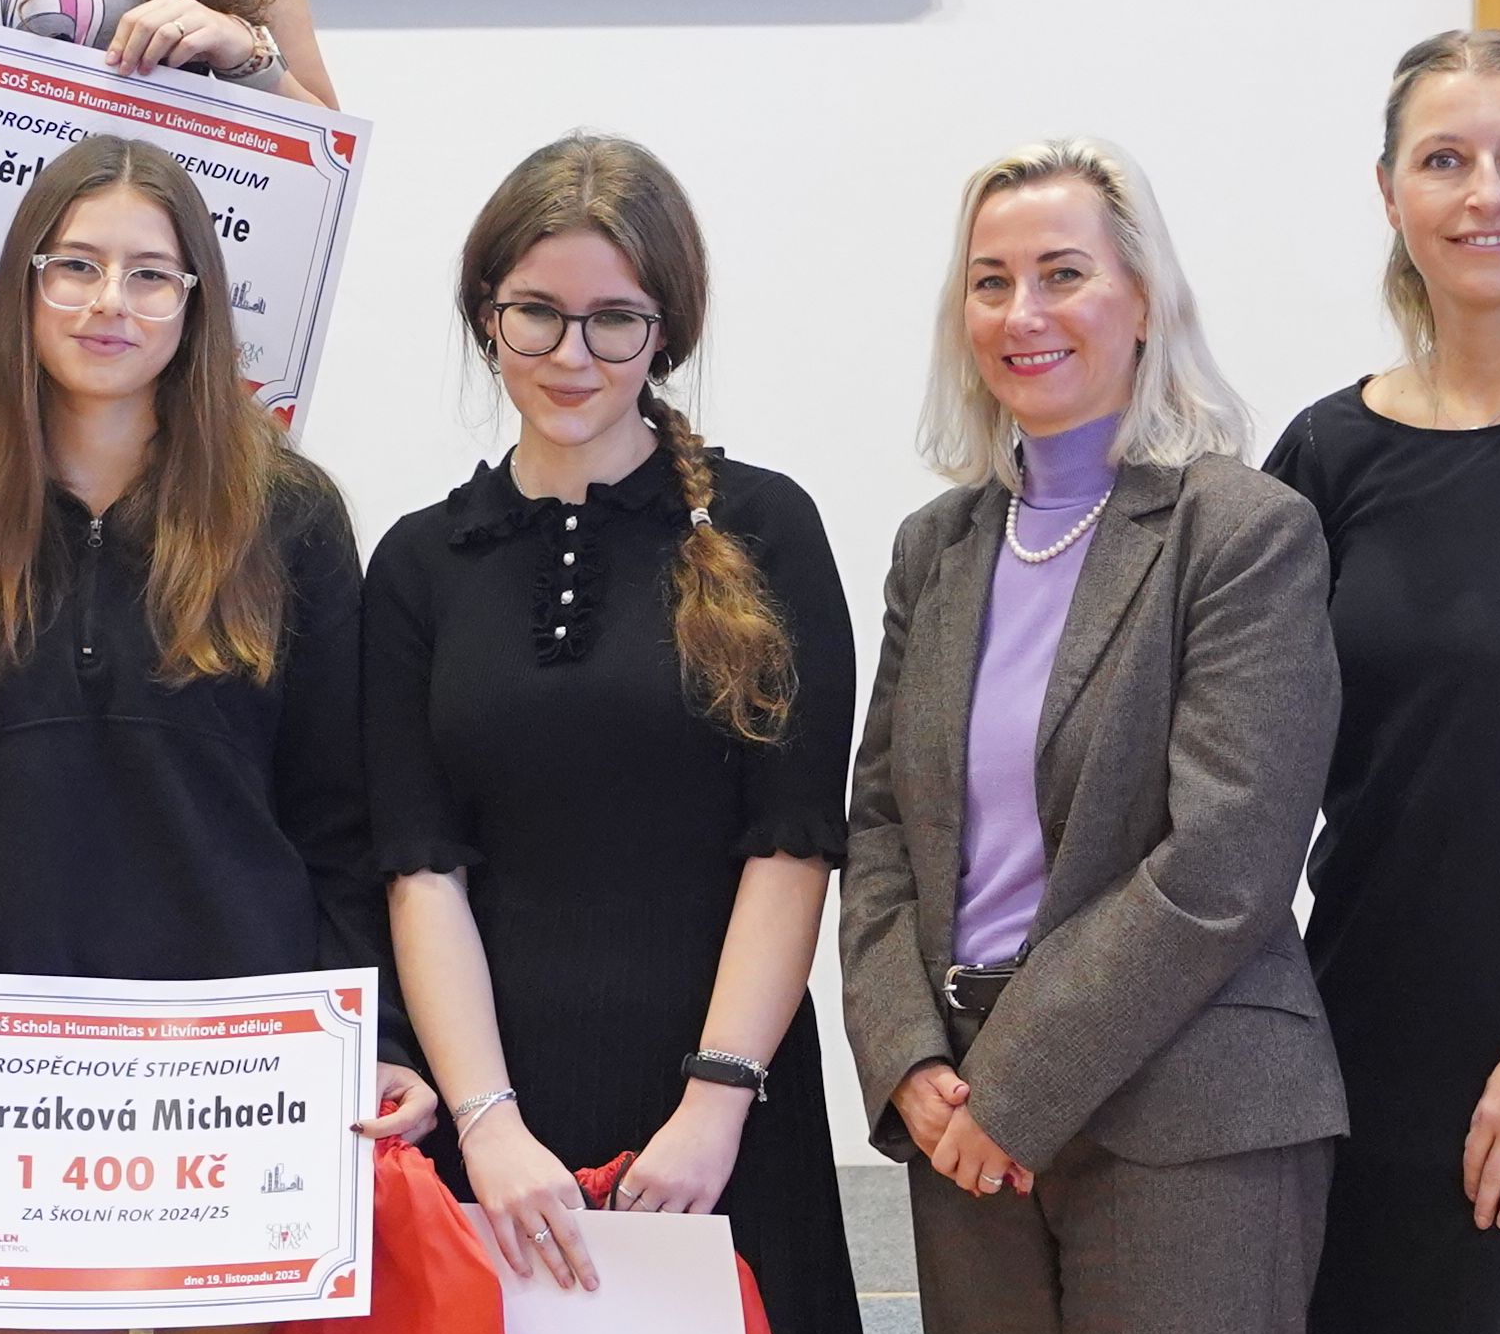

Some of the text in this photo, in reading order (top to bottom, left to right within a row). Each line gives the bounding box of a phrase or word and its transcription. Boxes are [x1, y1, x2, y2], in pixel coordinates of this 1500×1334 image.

[0, 70, 278, 153] SOŠ Schola Humanitas Litvínově uděluje
[13, 1019, 60, 1036] Schola
[64, 1020, 145, 1037] Humanitas
[148, 1027, 158, 1037] v
[161, 1020, 226, 1038] Litvínově
[229, 1017, 282, 1037] uděluje
[144, 1056, 280, 1078] STIPENDIUM
[152, 1091, 306, 1131] Michaela
[18, 1153, 228, 1191] 1 400 Kč
[21, 1204, 230, 1222] ZA ŠKOLNÍ ROK 2024/25
[183, 1275, 204, 1286] dne
[206, 1274, 223, 1284] 19.
[225, 1271, 273, 1286] listopadu
[275, 1270, 301, 1281] 2025
